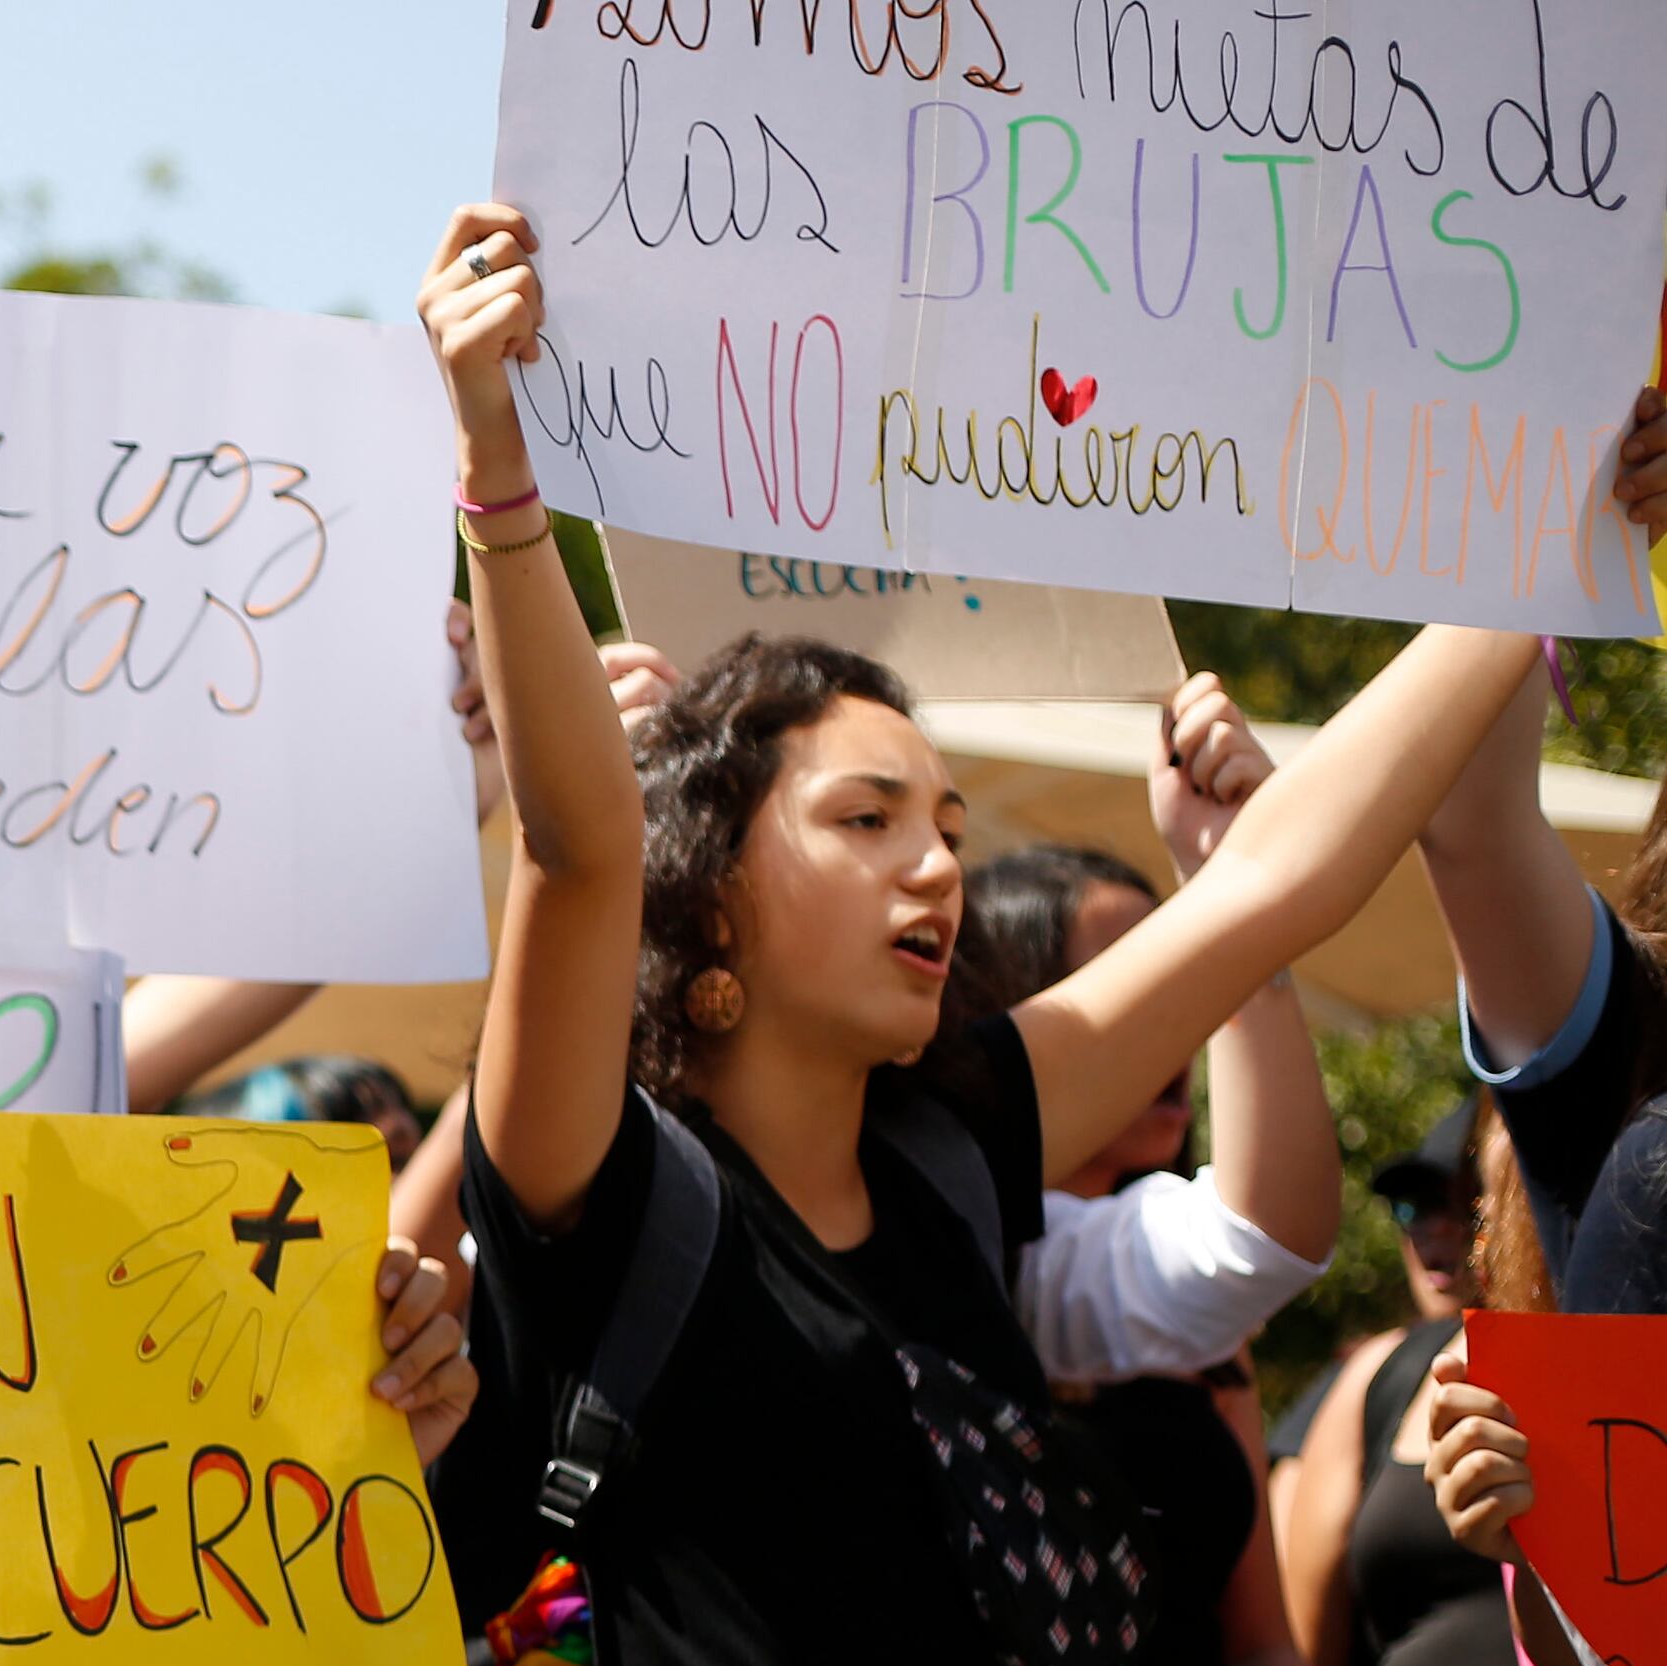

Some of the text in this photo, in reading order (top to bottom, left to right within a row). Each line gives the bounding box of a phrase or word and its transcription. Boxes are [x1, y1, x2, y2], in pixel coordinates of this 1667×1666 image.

[571, 57, 1522, 373] las BRUJAS
[1485, 0, 1628, 211] de
[95, 437, 355, 619] voz
[715, 313, 844, 532] NO
[867, 312, 1255, 552] pudieron
